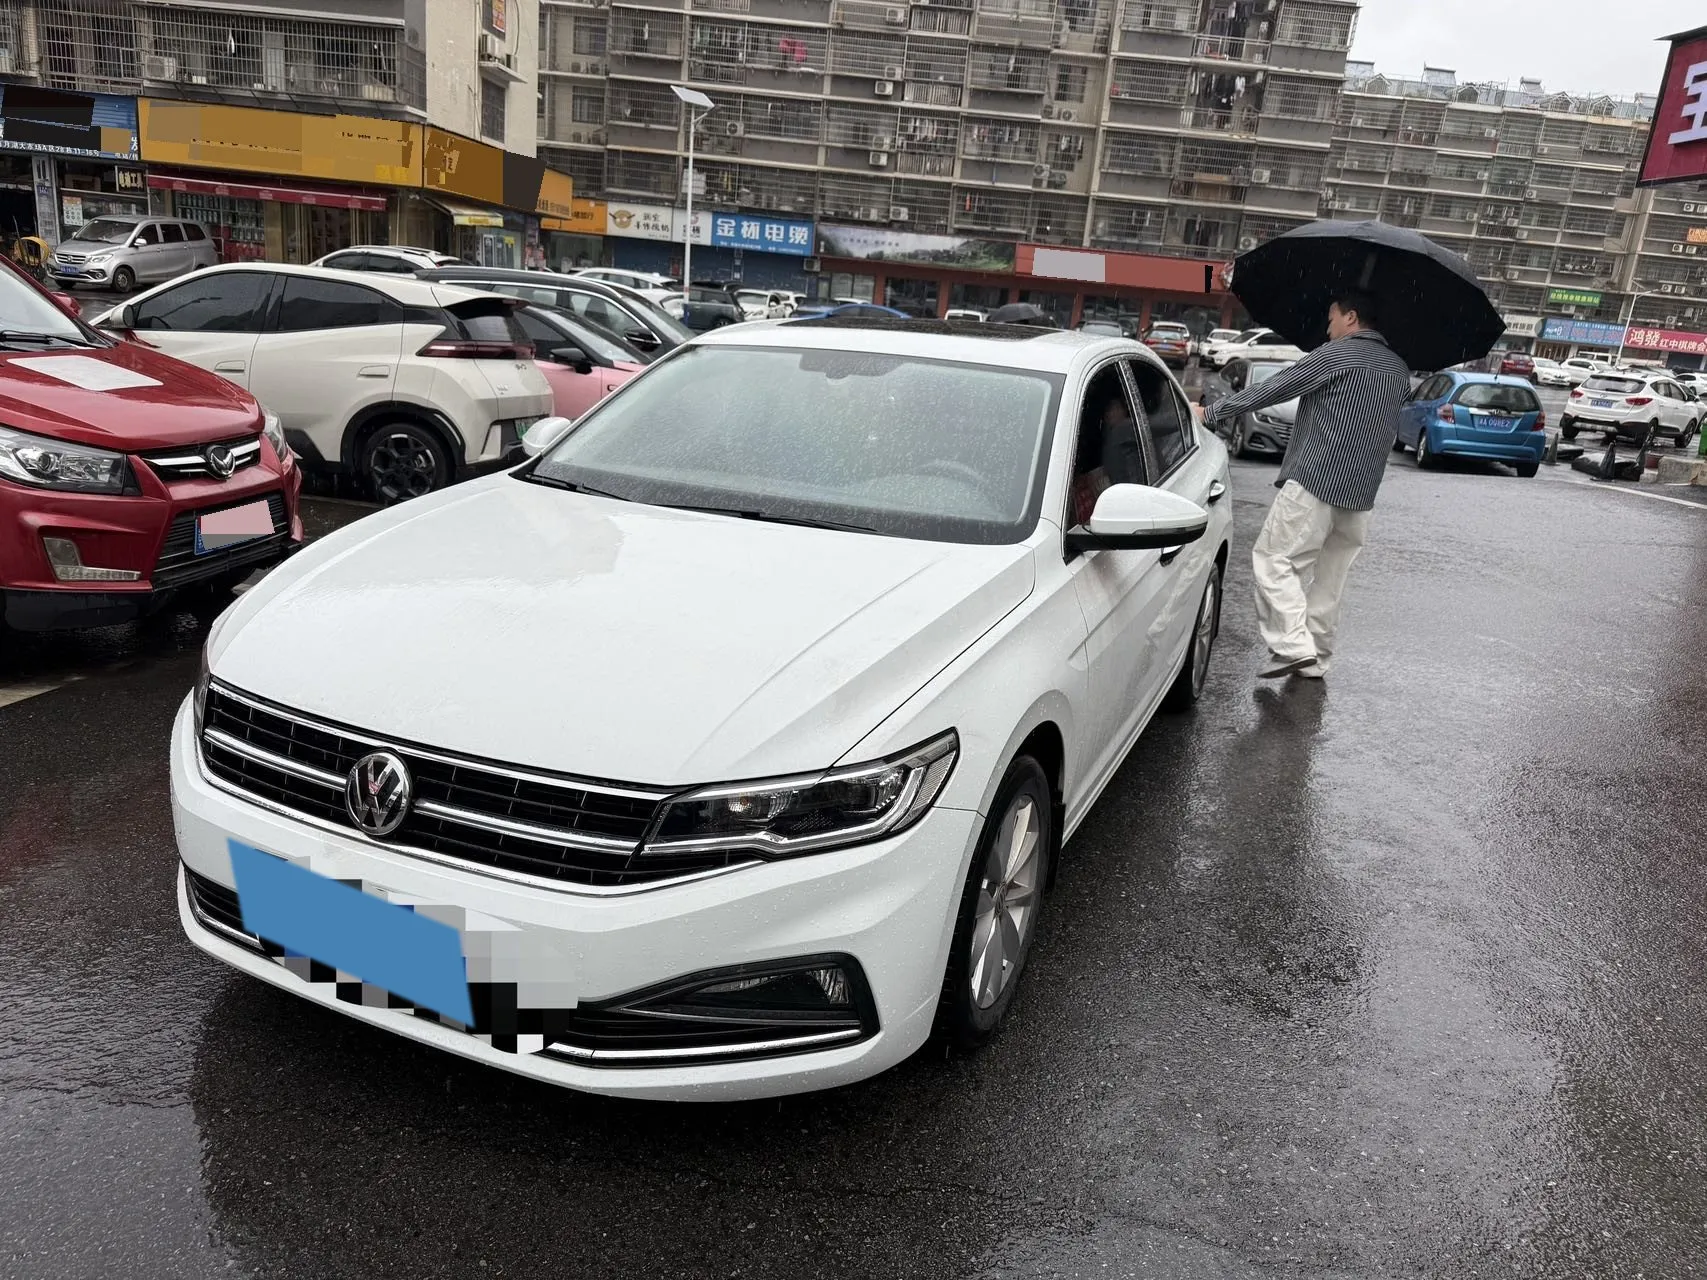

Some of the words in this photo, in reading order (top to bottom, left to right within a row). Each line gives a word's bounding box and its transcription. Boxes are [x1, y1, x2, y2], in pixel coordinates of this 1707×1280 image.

[716, 217, 809, 245] 金杯电缆
[1659, 338, 1707, 352] 红中棋牌会
